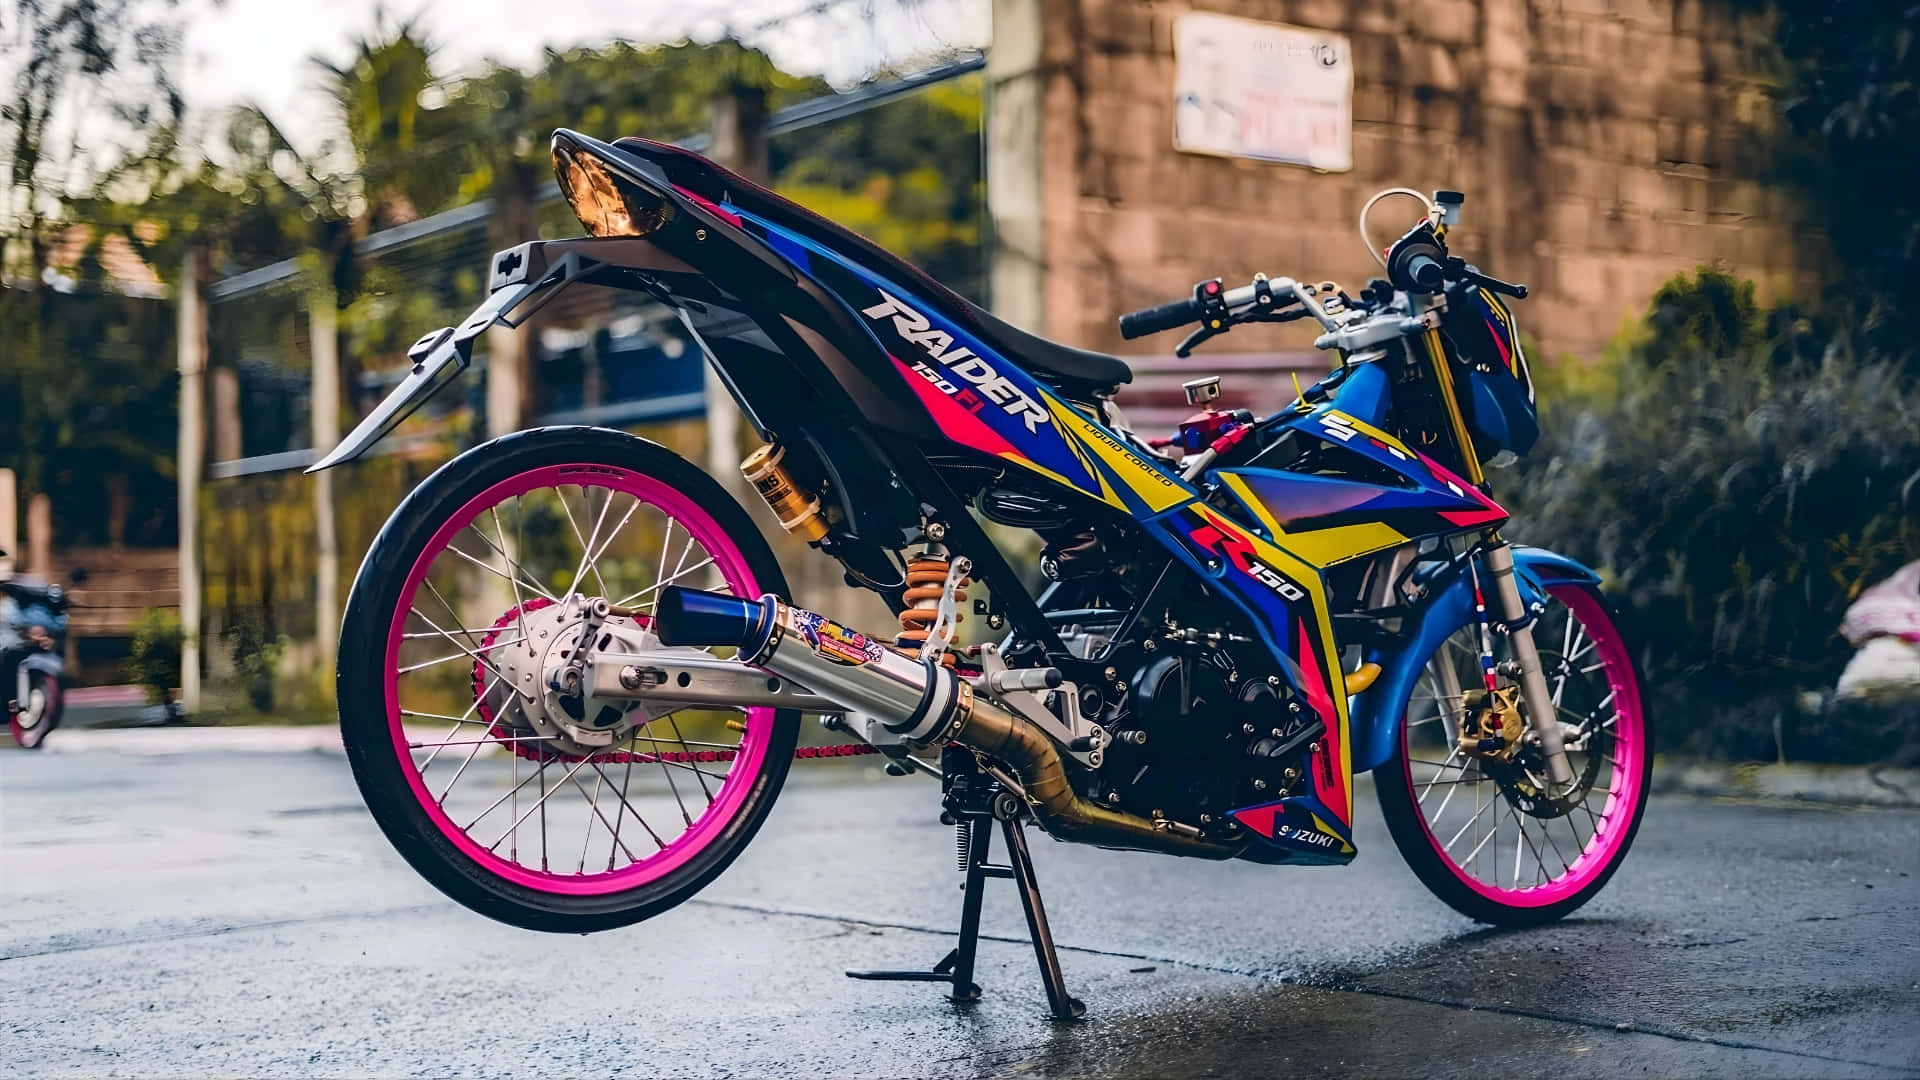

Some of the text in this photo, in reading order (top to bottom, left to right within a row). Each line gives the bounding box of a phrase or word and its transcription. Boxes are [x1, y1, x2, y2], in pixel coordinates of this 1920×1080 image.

[861, 287, 1050, 435] RAIDER
[1083, 423, 1173, 487] LIQUID COOLED
